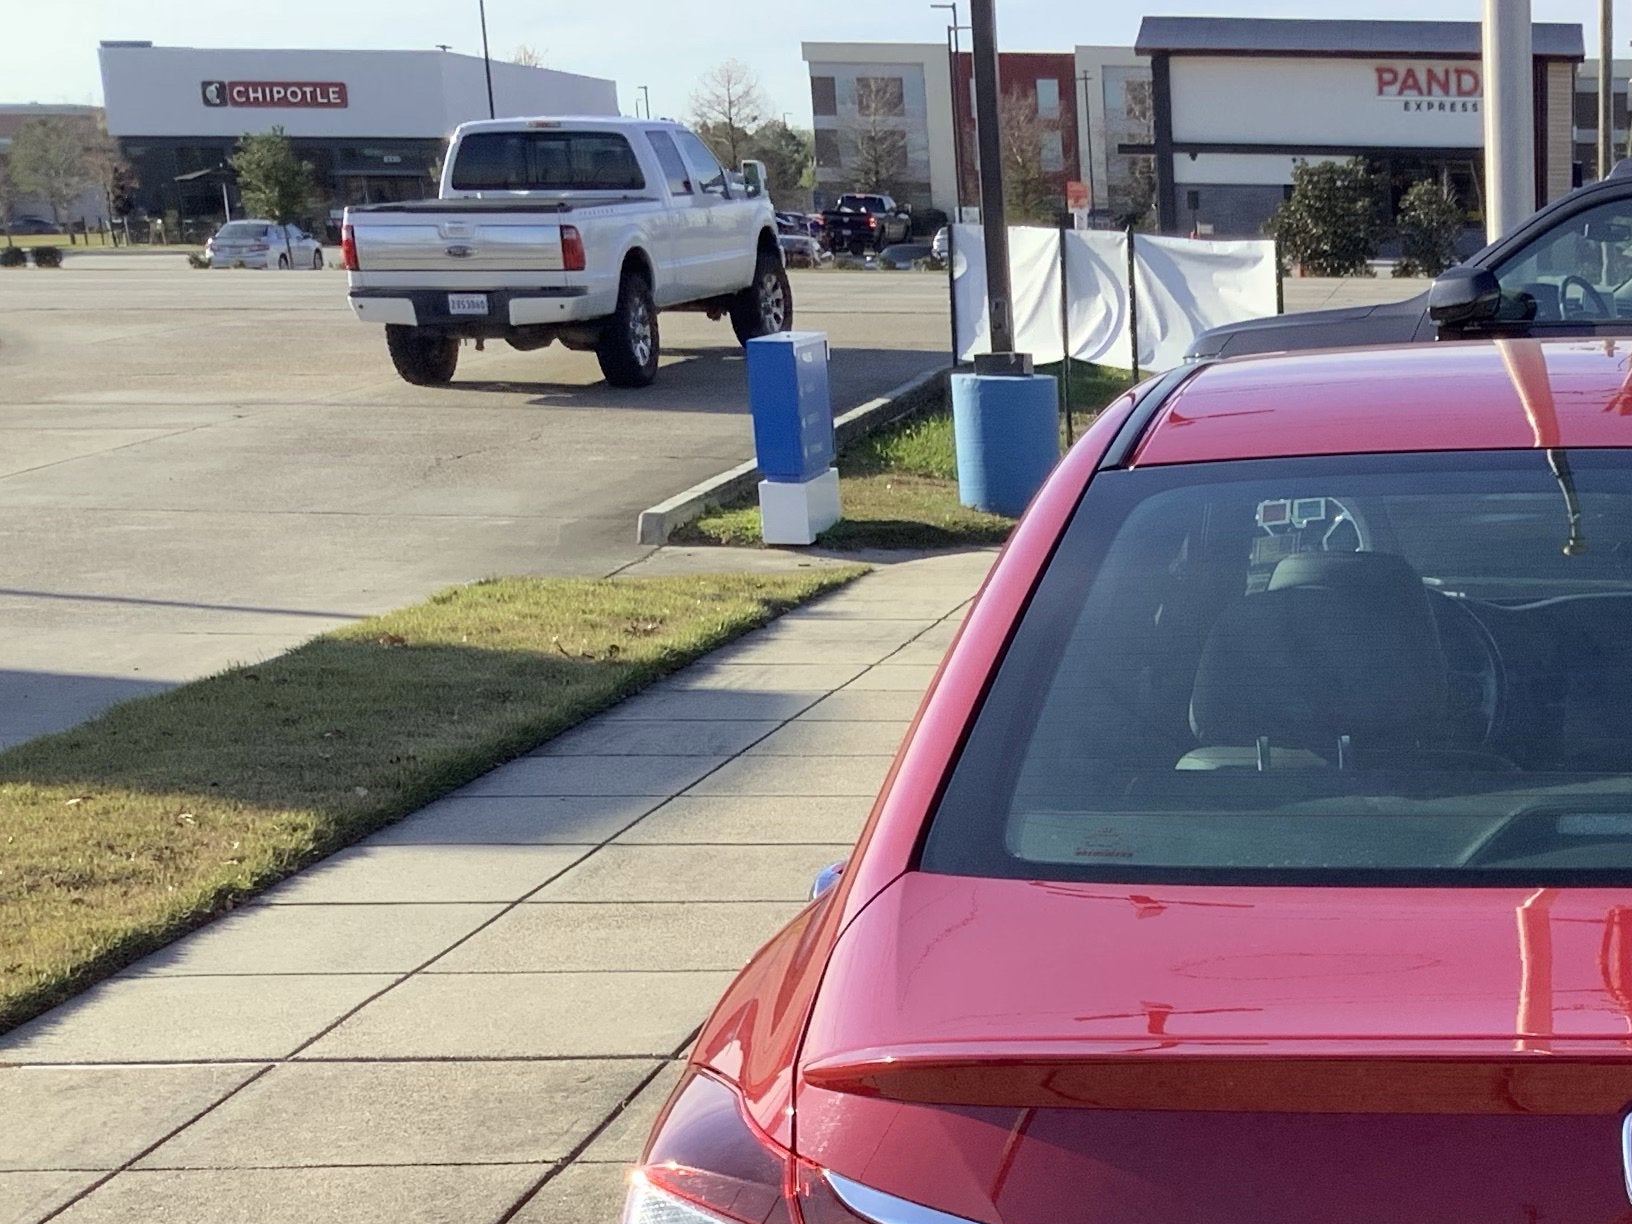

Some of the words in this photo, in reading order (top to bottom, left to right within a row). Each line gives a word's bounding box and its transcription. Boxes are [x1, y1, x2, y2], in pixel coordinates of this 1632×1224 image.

[1375, 67, 1483, 97] PAND
[232, 86, 341, 103] CHIPOTLE
[1403, 101, 1478, 112] EXPRESS
